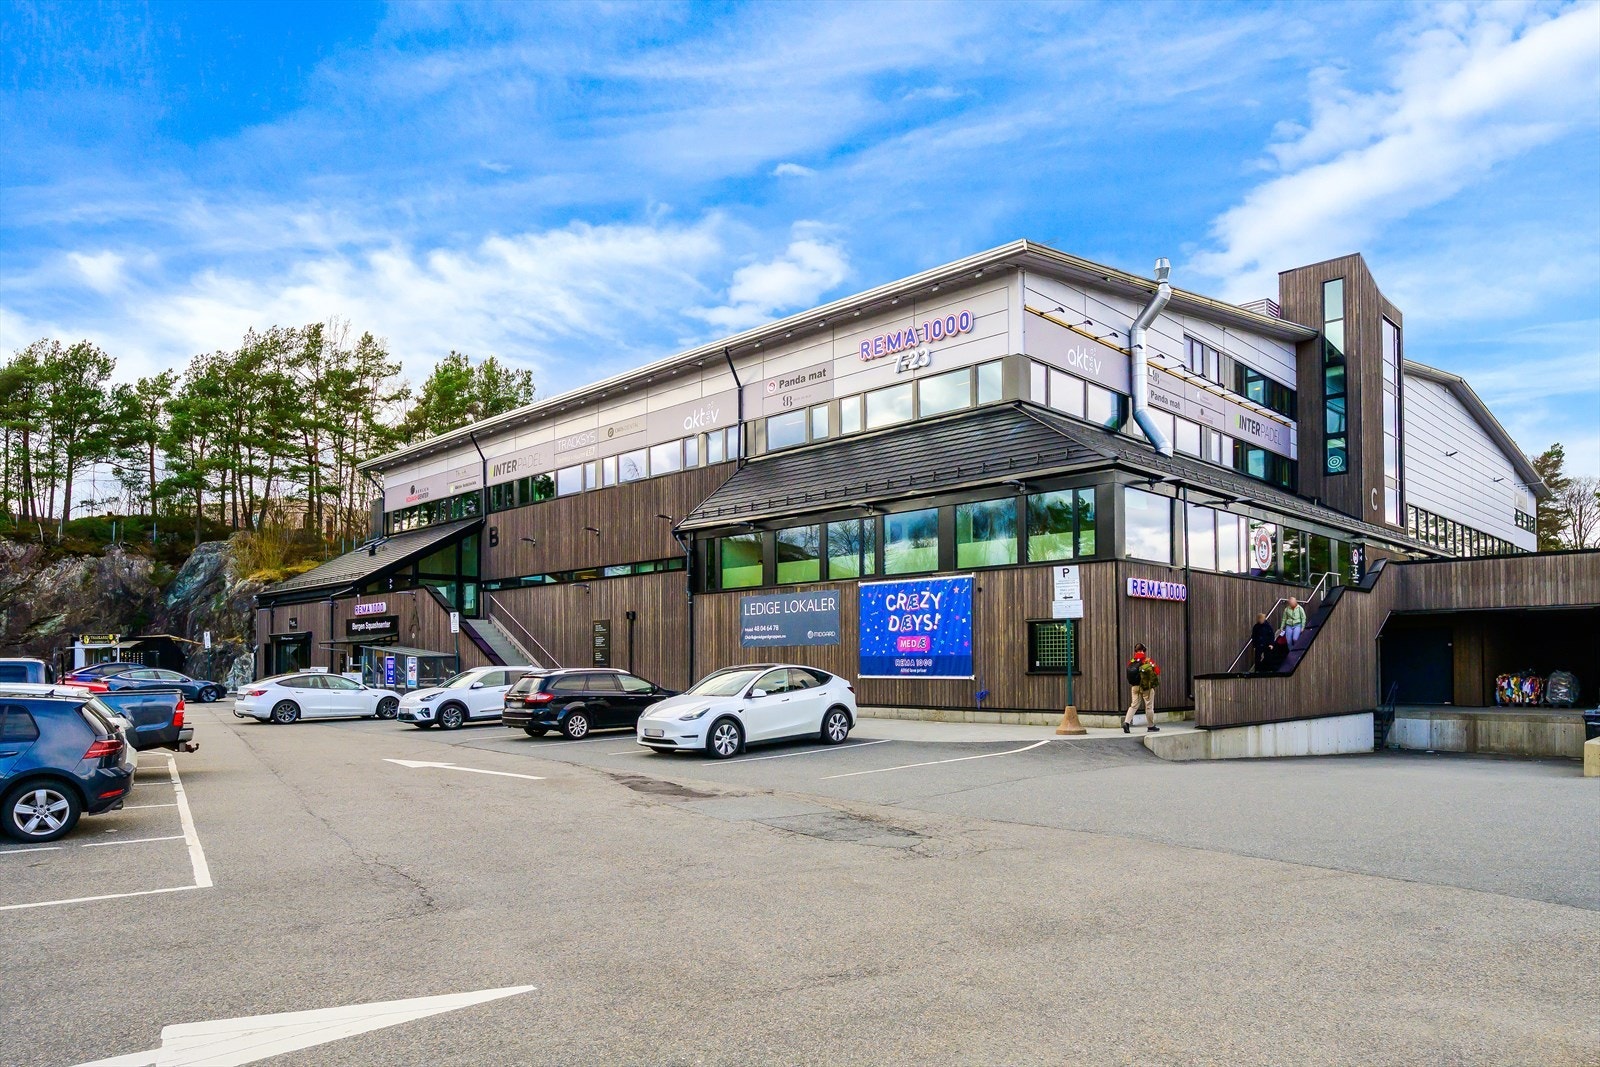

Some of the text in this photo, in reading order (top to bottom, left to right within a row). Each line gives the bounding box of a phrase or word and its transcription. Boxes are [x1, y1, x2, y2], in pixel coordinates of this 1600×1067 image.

[860, 310, 973, 361] REMA 1000
[893, 347, 931, 374] 7-23
[779, 368, 827, 389] Panda mat
[1150, 389, 1181, 410] Panda mat
[1236, 414, 1282, 446] INTERPADEL
[491, 452, 544, 478] INTERPADEL
[1371, 488, 1378, 511] C
[489, 526, 499, 548] B
[1062, 567, 1070, 578] P
[1132, 579, 1187, 600] REMA 1000
[355, 603, 385, 614] REMA 1000
[744, 597, 836, 616] LEDIGE LOKALER
[351, 622, 366, 632] Bergen
[900, 639, 917, 648] MED
[895, 658, 933, 667] REMA 1000
